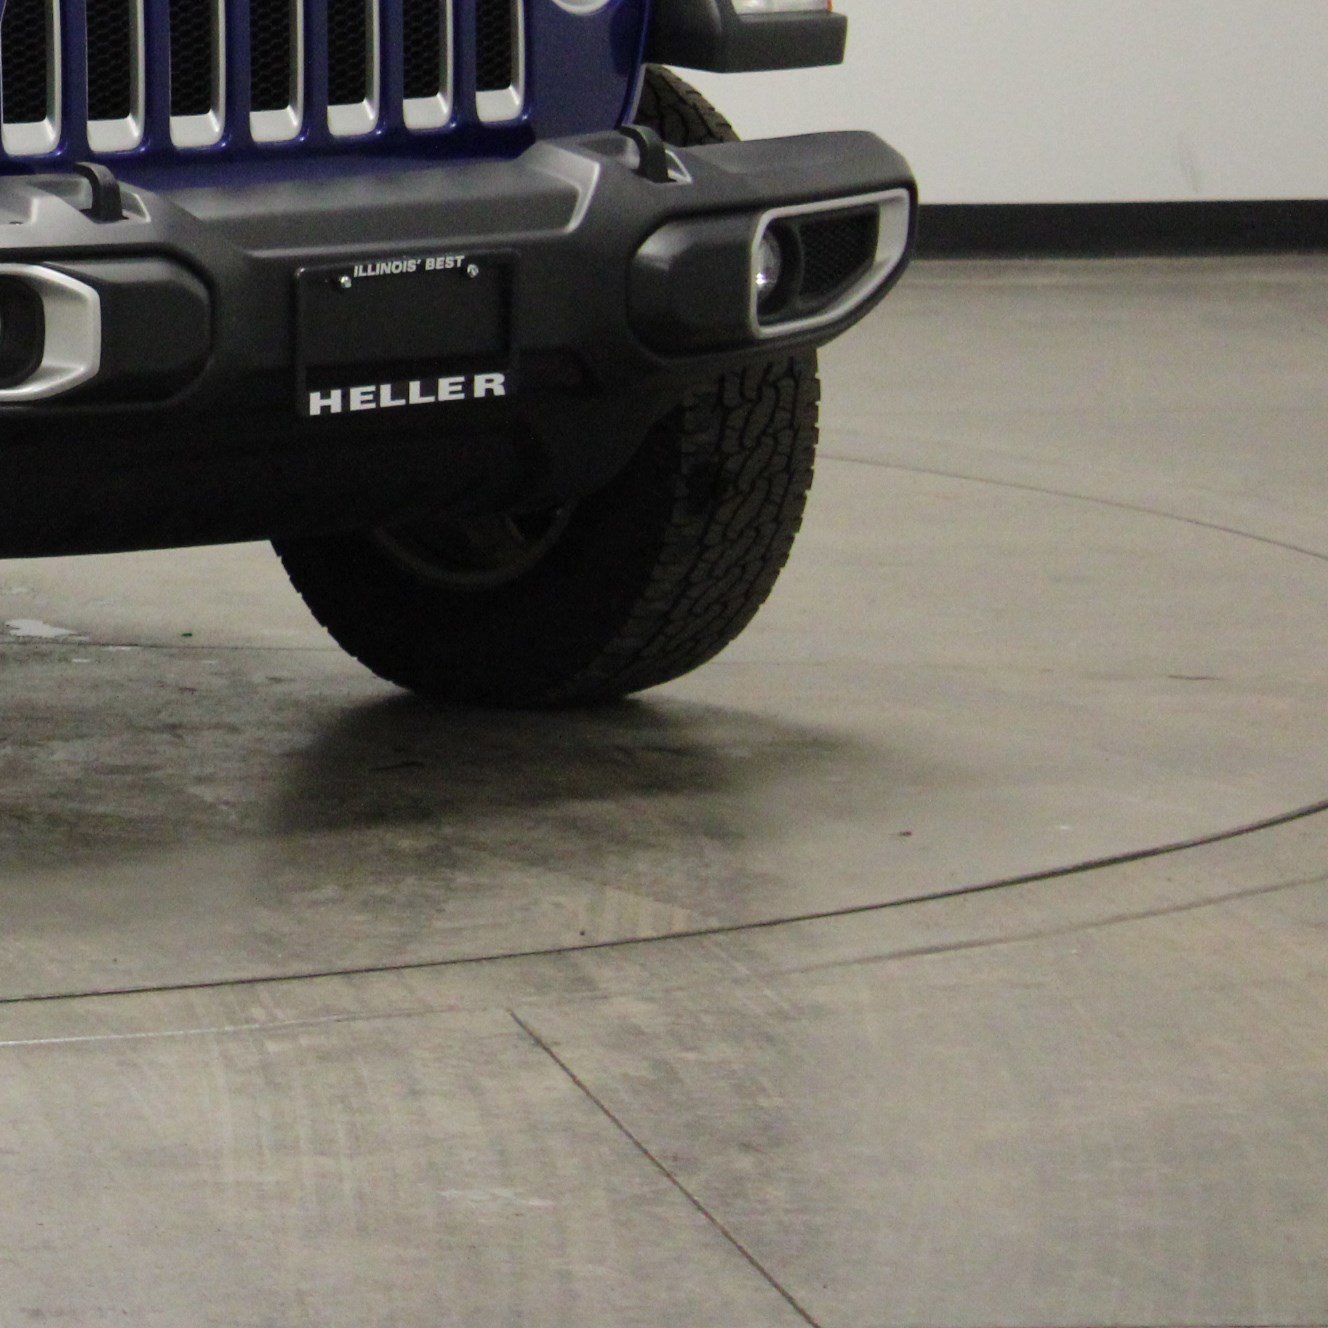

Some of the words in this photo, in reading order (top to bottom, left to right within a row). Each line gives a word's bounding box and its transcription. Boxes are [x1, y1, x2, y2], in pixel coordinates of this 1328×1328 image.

[353, 258, 421, 278] ILLINOIS'
[425, 255, 465, 271] BEST
[309, 372, 506, 416] HELLER
